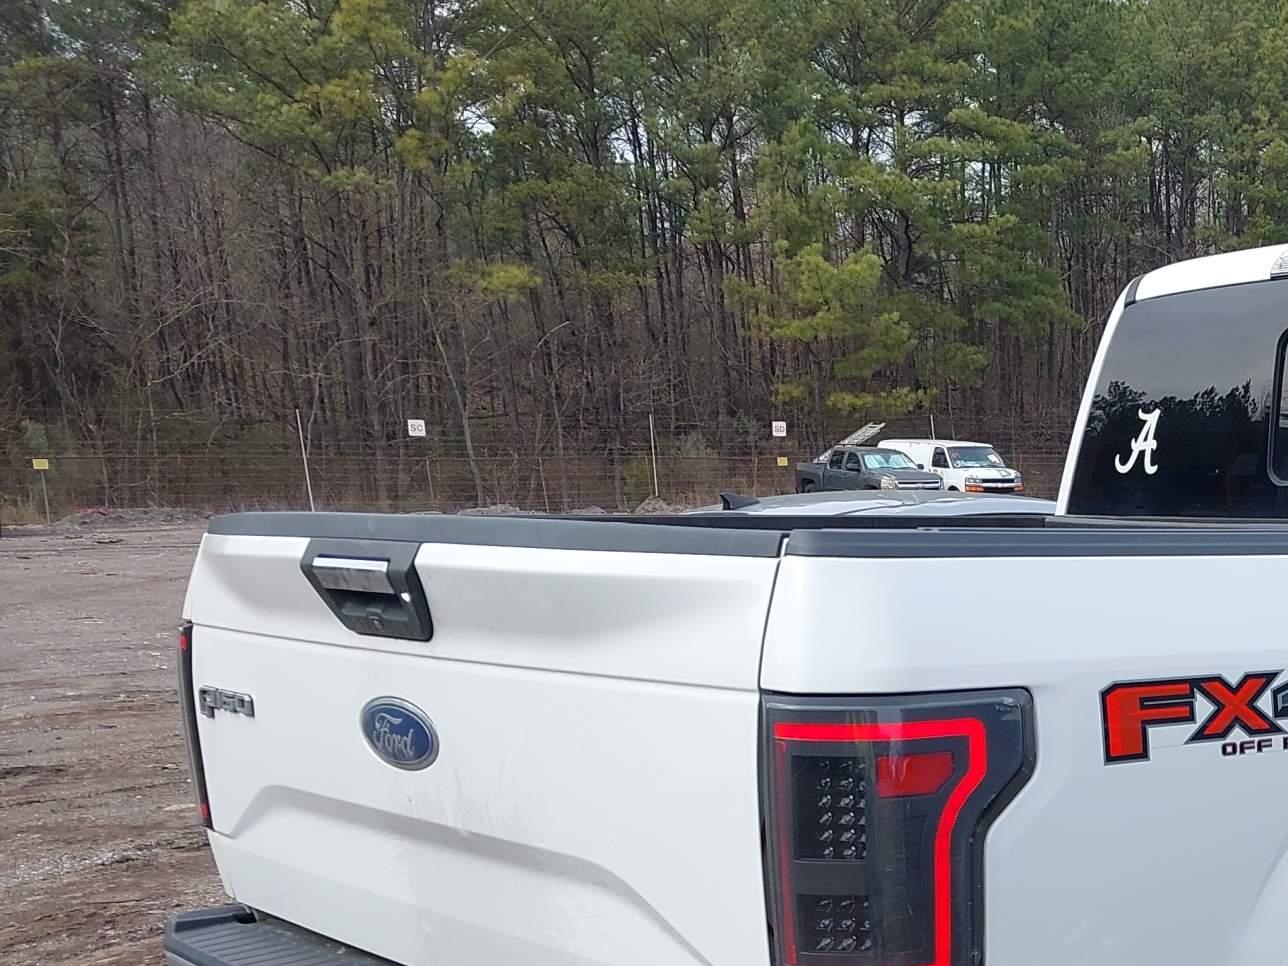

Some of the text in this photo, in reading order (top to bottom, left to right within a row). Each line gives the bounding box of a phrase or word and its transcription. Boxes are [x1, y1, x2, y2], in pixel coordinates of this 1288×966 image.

[410, 423, 424, 431] SC
[1115, 408, 1161, 474] A
[1221, 739, 1273, 757] OFF
